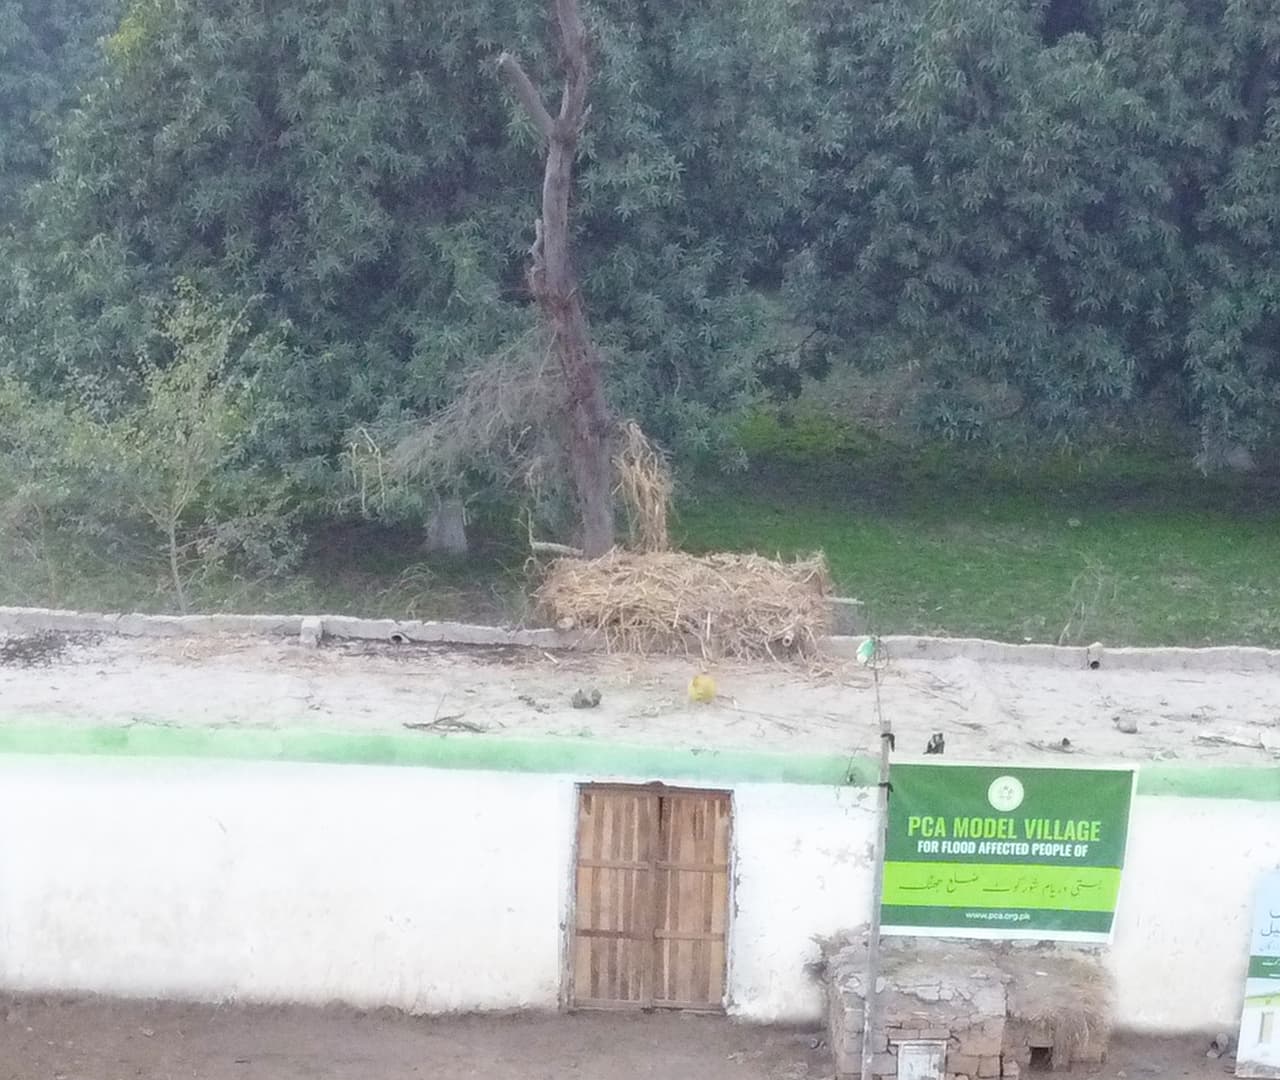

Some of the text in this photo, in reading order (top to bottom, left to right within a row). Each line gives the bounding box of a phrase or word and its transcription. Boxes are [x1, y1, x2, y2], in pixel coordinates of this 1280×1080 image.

[907, 815, 1102, 842] PCA MODEL VILLAGE
[917, 840, 1090, 858] FOR FLOOD AFFECTED PEOPLE OF
[965, 912, 1031, 923] www.pca.org.pk
